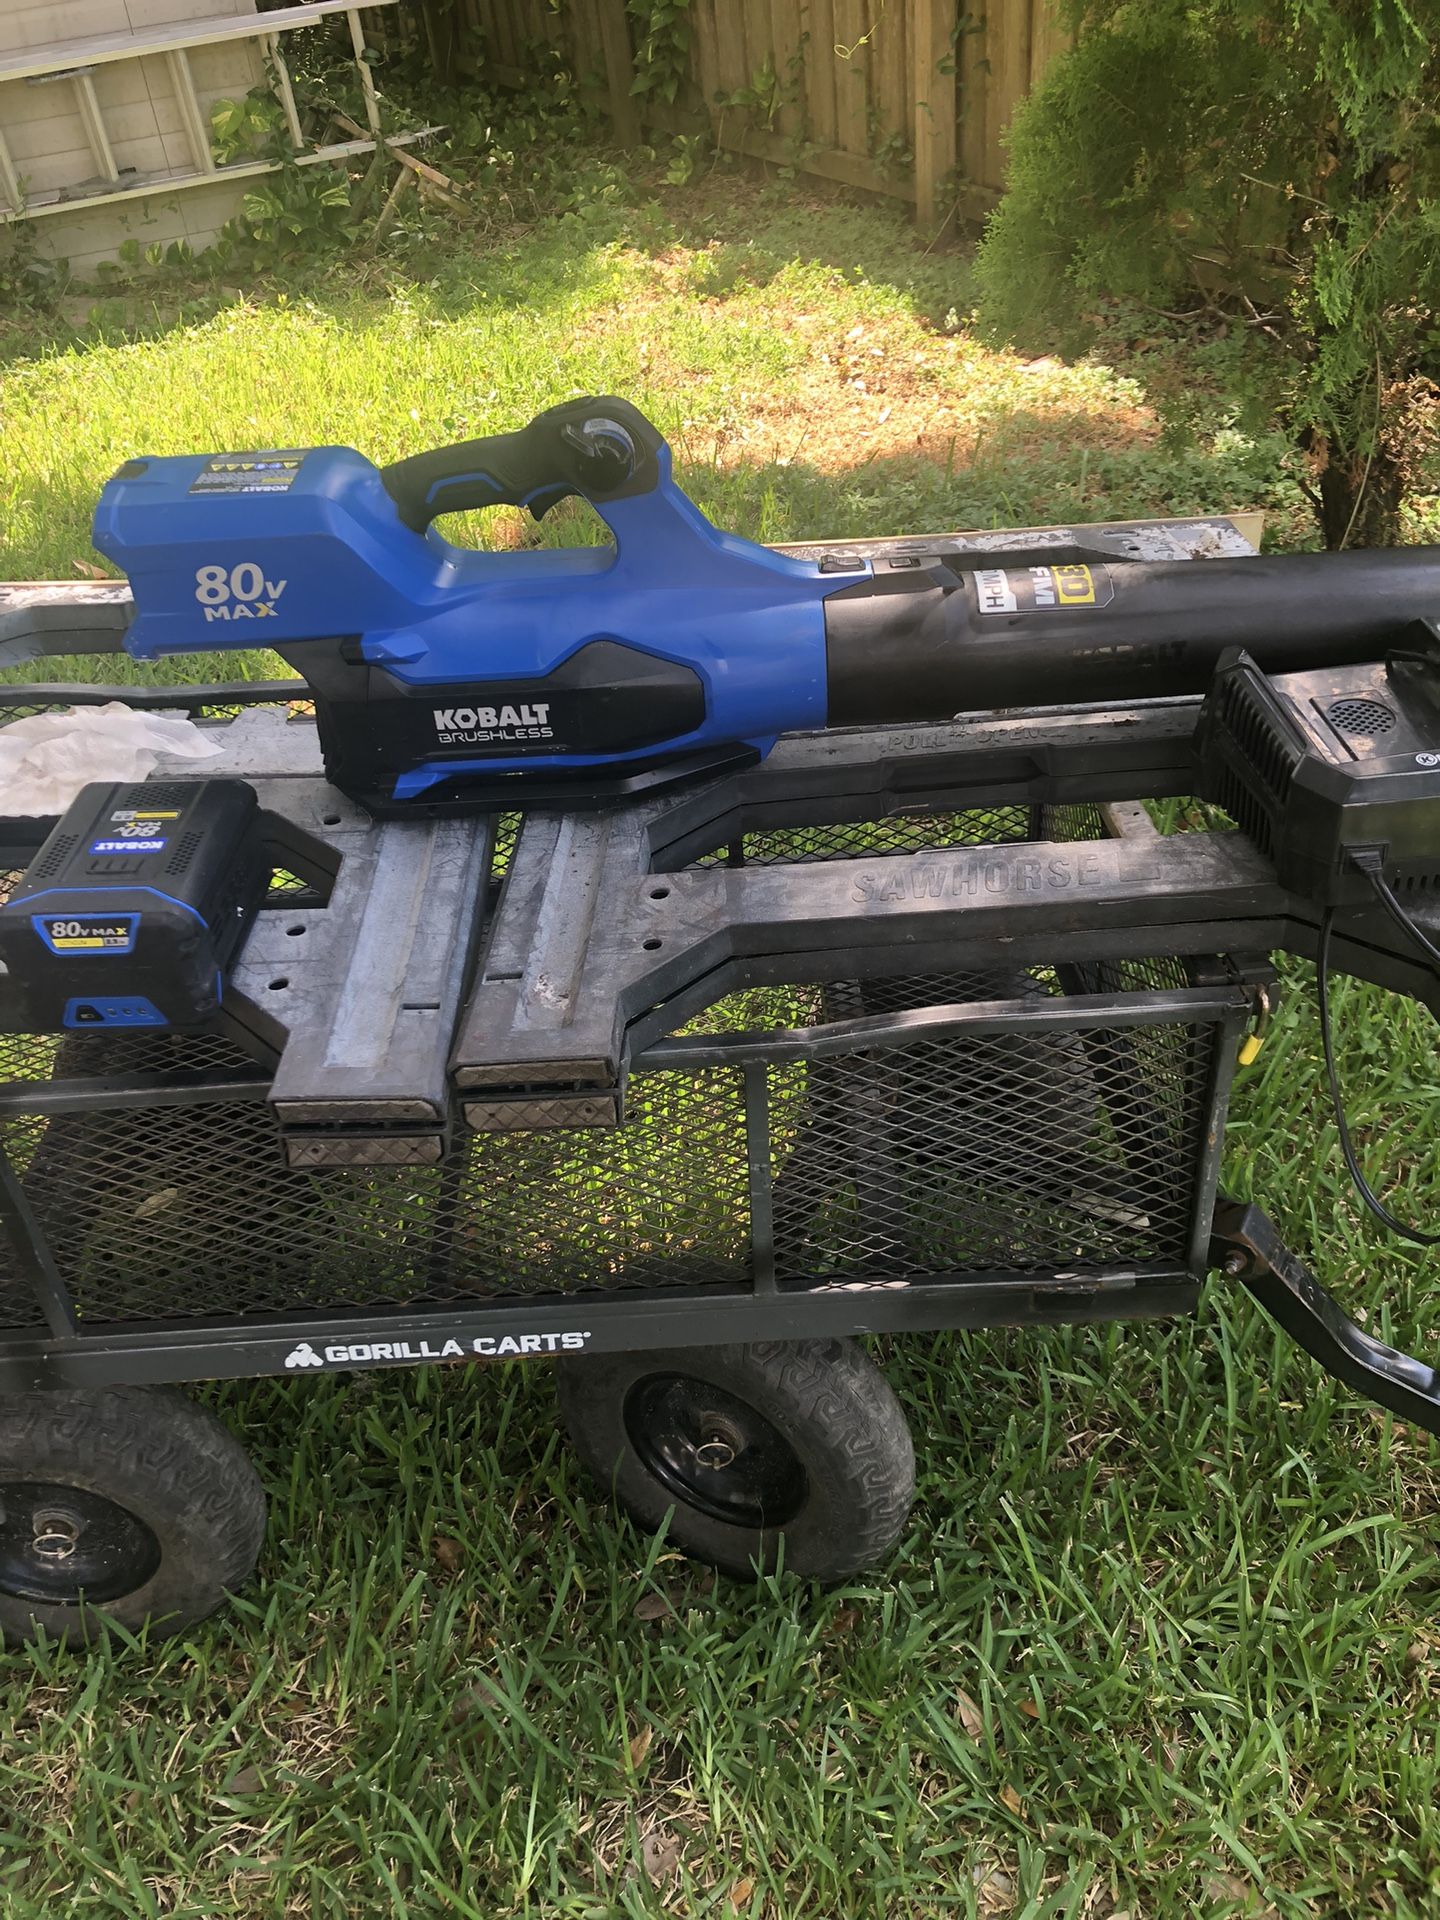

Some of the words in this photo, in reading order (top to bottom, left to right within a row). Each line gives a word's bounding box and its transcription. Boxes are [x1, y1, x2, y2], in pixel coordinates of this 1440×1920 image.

[982, 570, 1005, 608] MPH
[203, 601, 279, 622] MAX
[433, 703, 550, 730] KOBALT
[438, 727, 554, 744] BRUSHLESS
[94, 841, 165, 850] KOBALT
[851, 853, 1103, 904] SAWHORSE
[92, 927, 128, 936] MAX
[324, 1339, 465, 1363] GORILLA
[473, 1331, 586, 1356] CARTS
